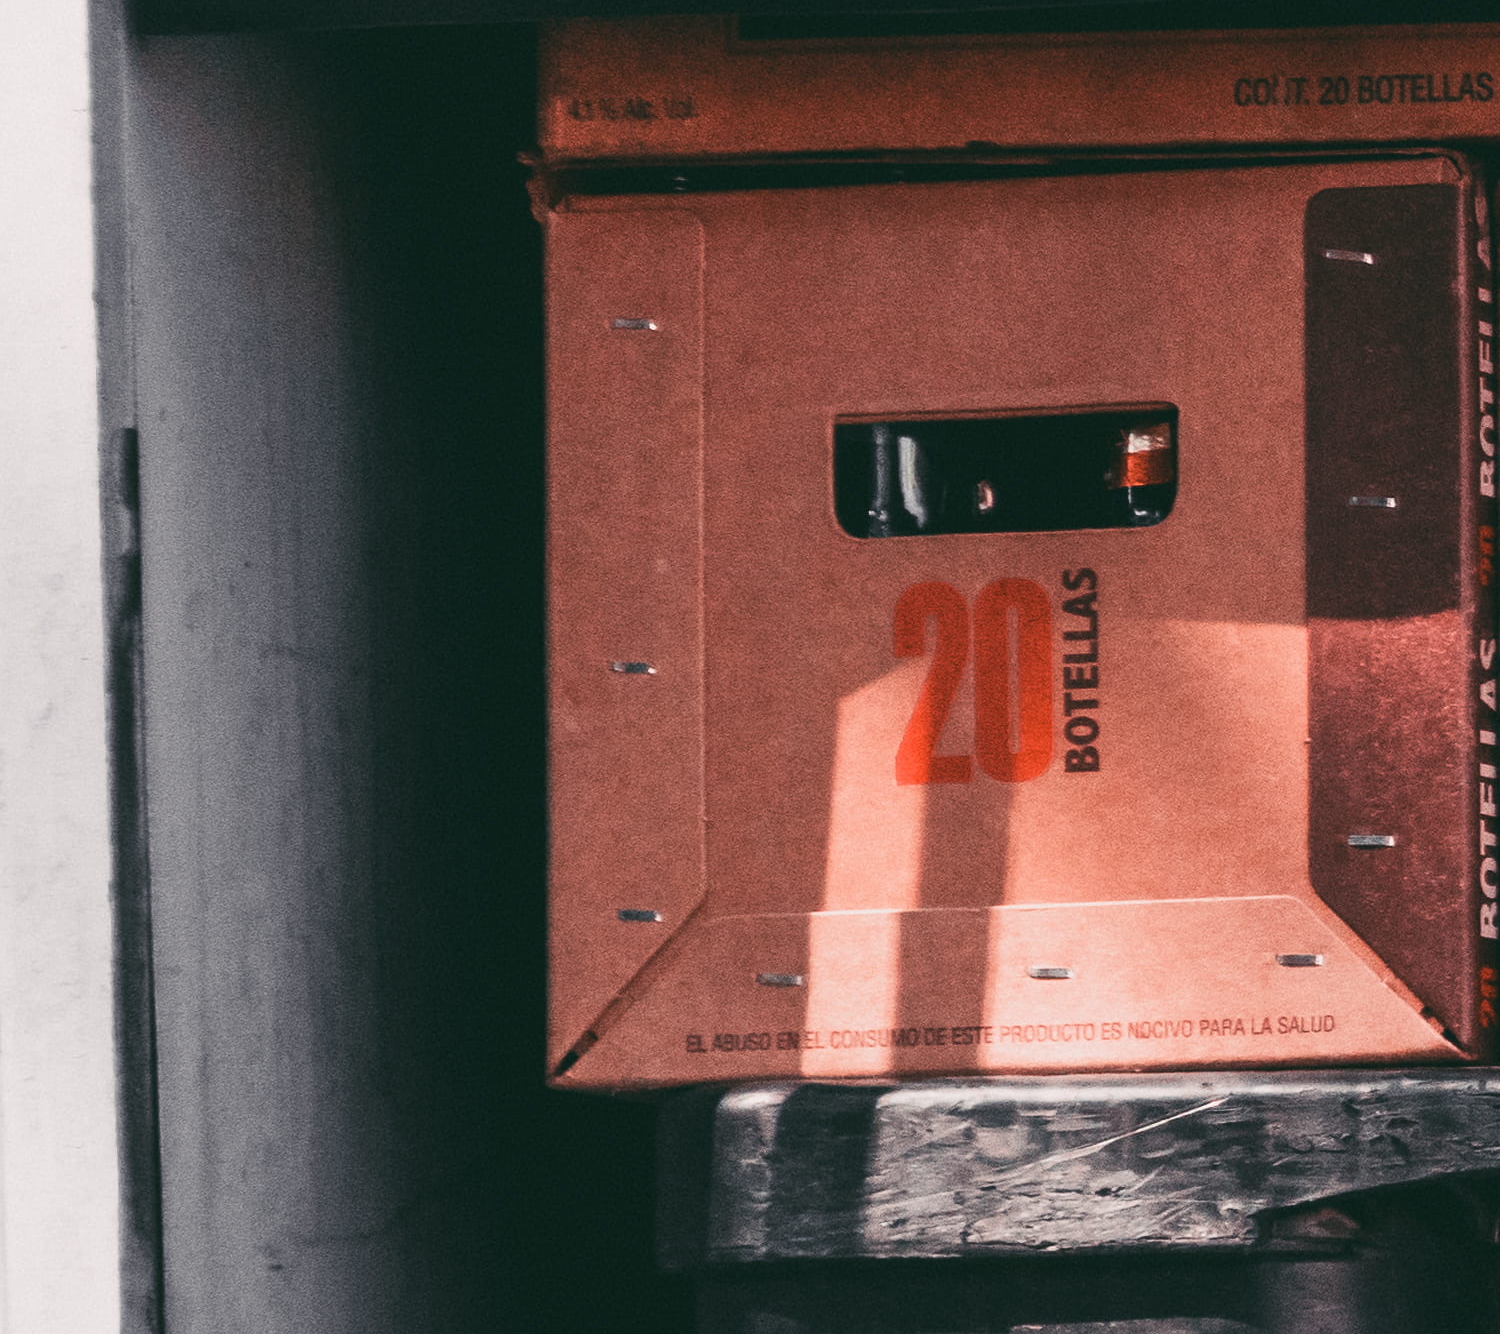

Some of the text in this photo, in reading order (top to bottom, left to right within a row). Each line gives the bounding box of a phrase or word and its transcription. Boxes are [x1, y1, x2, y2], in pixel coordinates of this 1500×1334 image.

[1319, 74, 1350, 106] 20
[1357, 71, 1494, 105] BOTELLAS
[893, 577, 1053, 787] 20
[1063, 567, 1101, 774] BOTELLAS
[685, 1013, 1337, 1055] EL ABUSO EN EL CONSUMO DE ESTE PRODUCTO ES NOCIVO PARA LA SALUD
